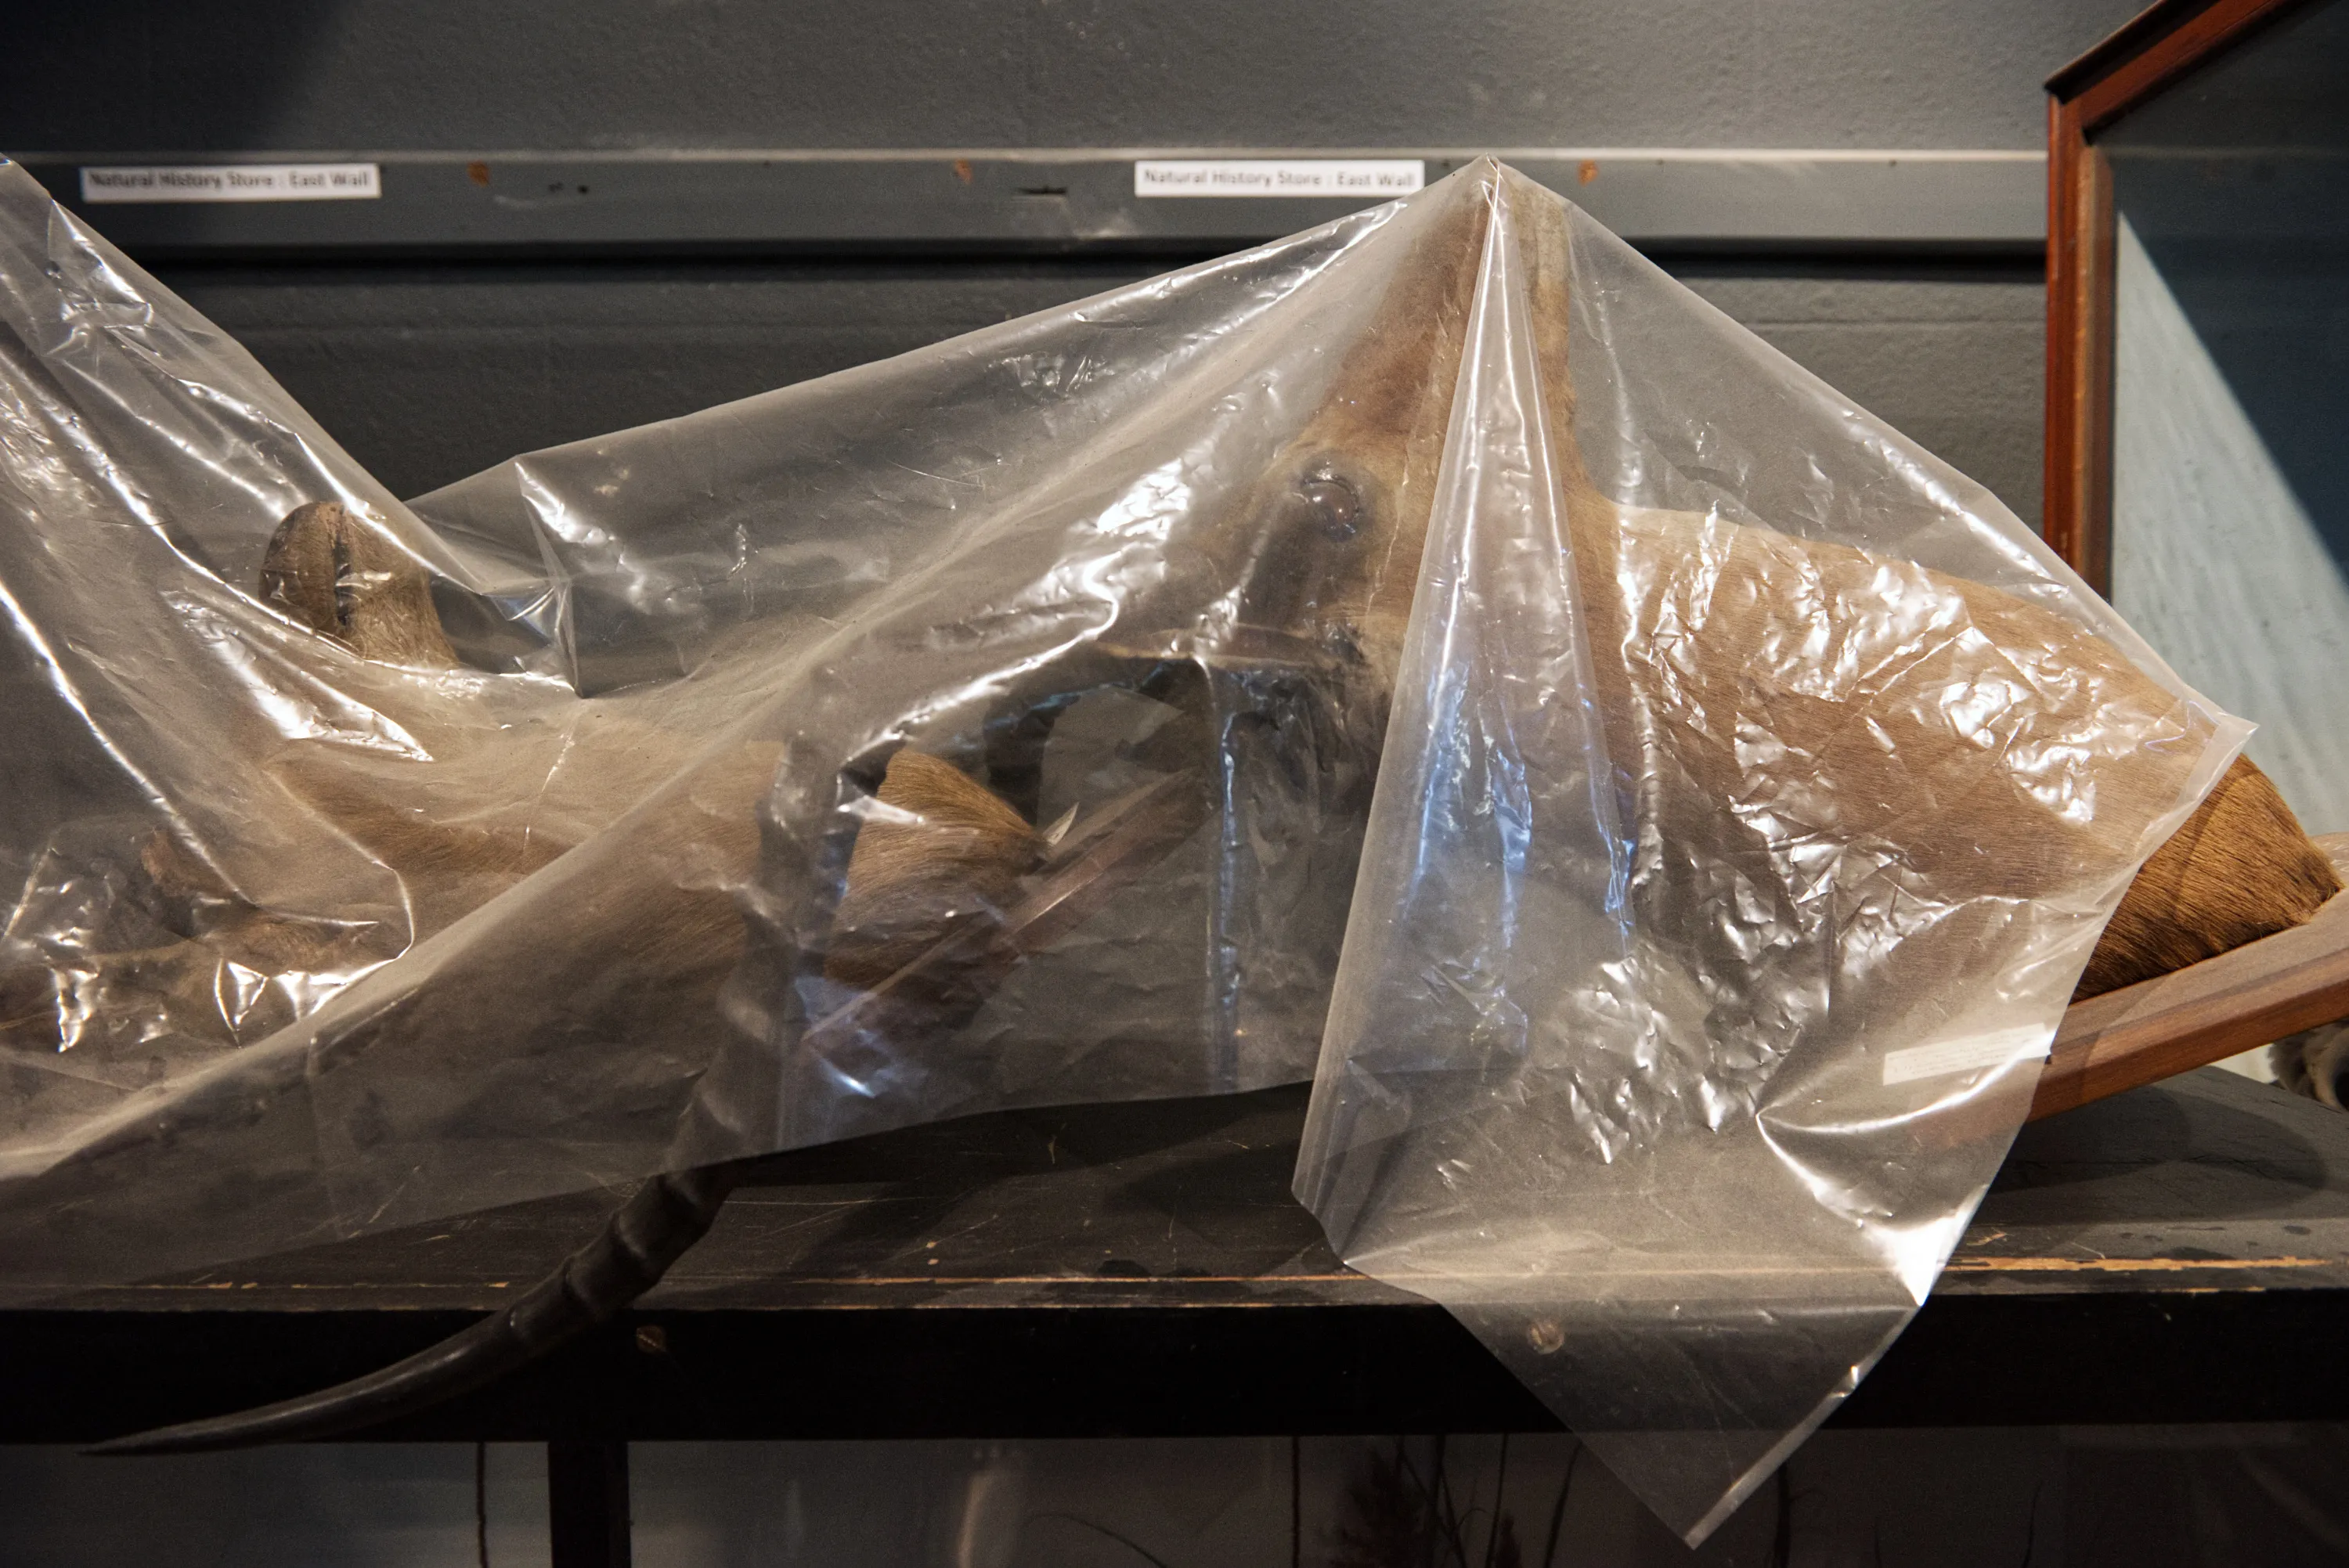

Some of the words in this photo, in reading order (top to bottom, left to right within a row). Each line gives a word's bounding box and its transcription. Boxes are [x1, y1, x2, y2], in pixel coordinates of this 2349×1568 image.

[88, 172, 153, 188] Natural
[159, 172, 221, 189] History
[226, 171, 272, 187] Store
[289, 171, 326, 187] East
[332, 171, 368, 187] Wall
[1144, 169, 1207, 184] Natural
[1212, 170, 1272, 189] History
[1277, 169, 1321, 185] Store
[1337, 170, 1371, 186] East
[1378, 170, 1414, 186] Wall
